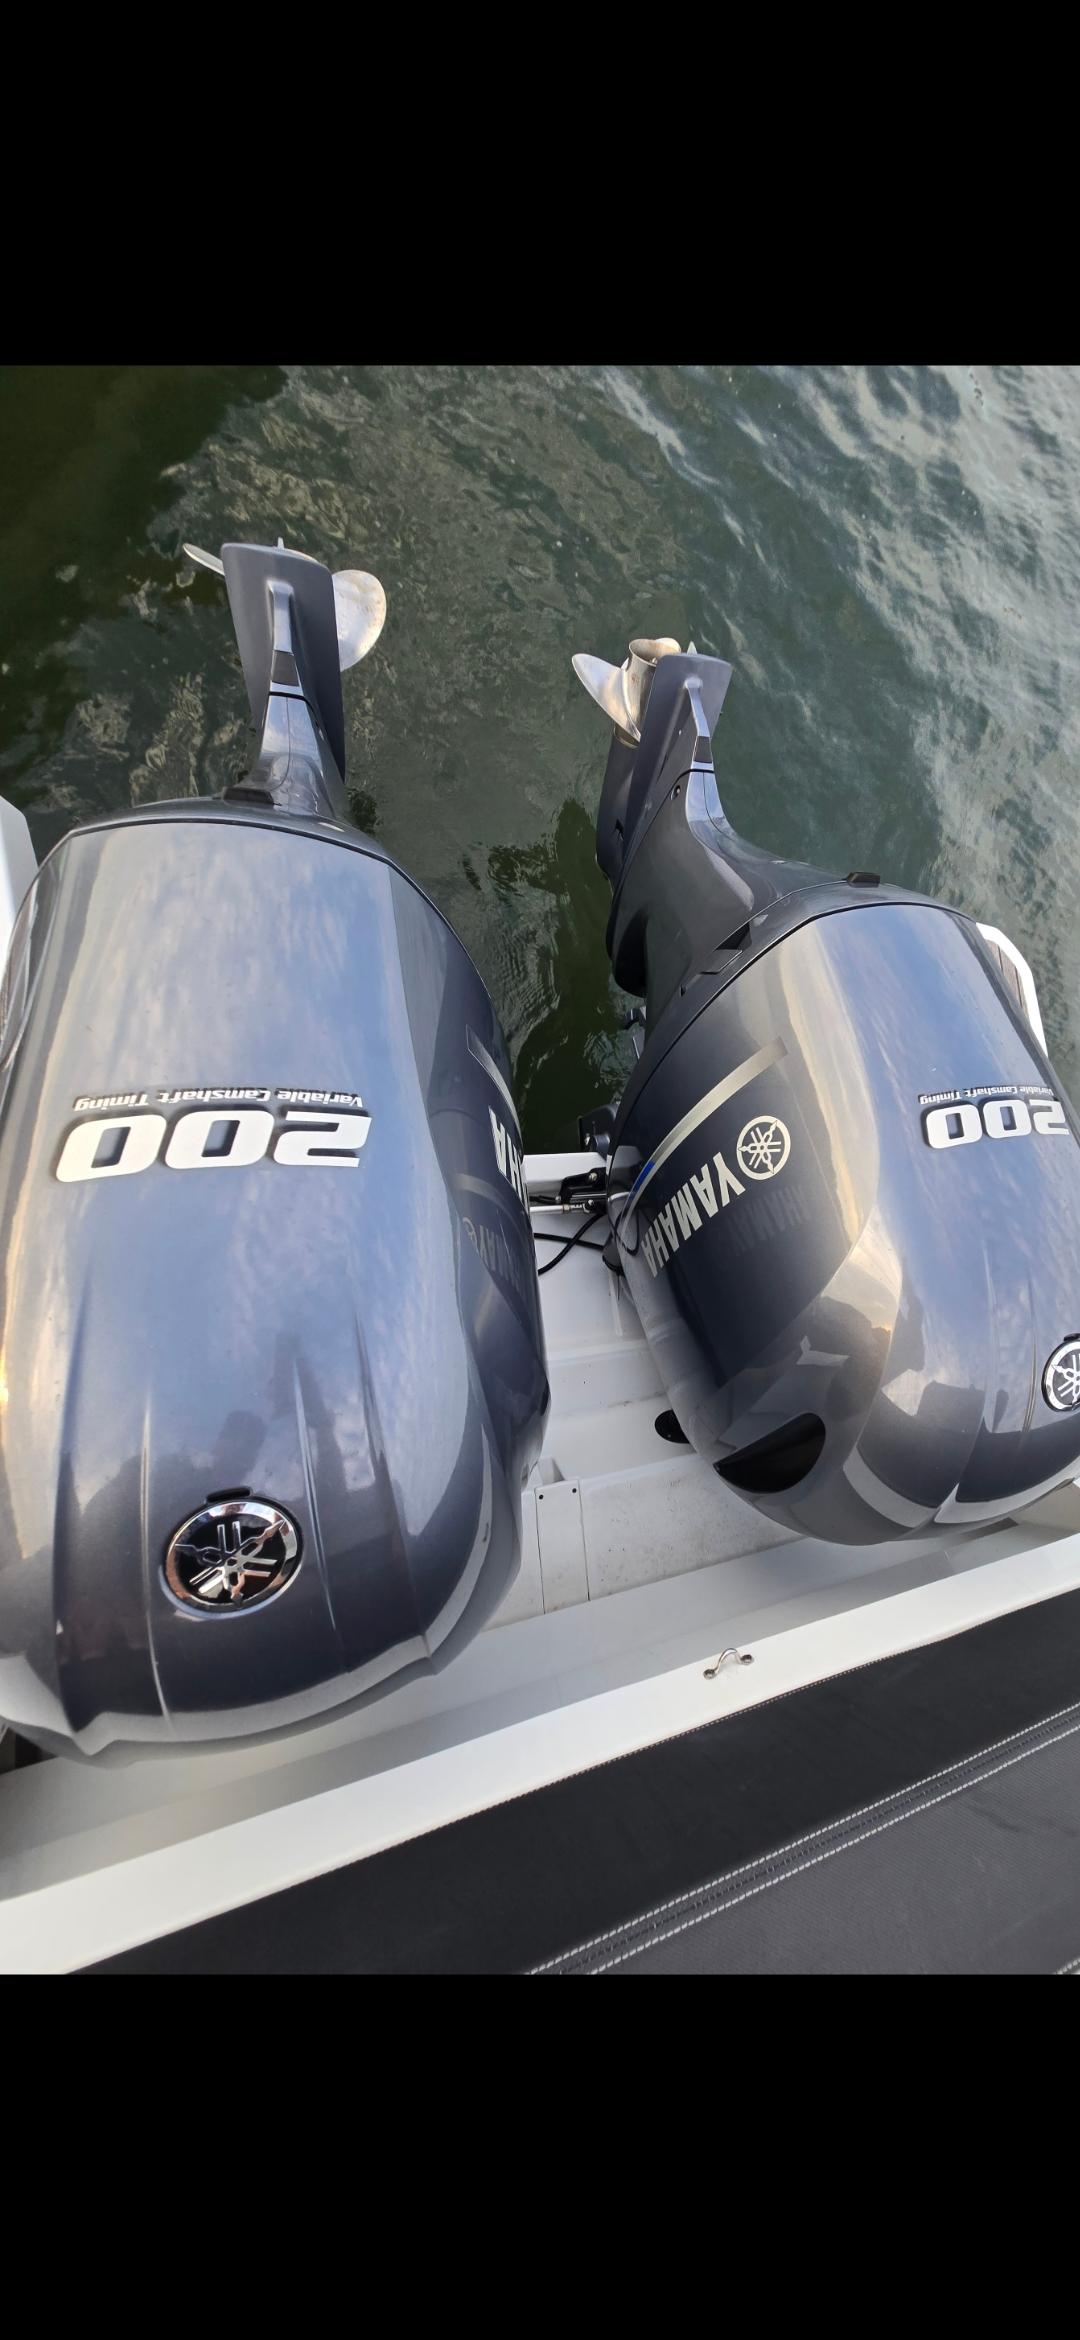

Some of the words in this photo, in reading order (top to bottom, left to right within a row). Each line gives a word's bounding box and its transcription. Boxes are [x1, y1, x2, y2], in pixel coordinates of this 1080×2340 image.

[158, 1089, 271, 1103] Camshaft
[277, 1090, 364, 1107] Variable
[919, 1090, 962, 1105] Timing
[964, 1086, 1018, 1099] Camshaft
[74, 1093, 149, 1112] Timing
[925, 1099, 1070, 1149] 200
[56, 1110, 372, 1183] 200
[640, 1151, 746, 1278] YAMAHA
